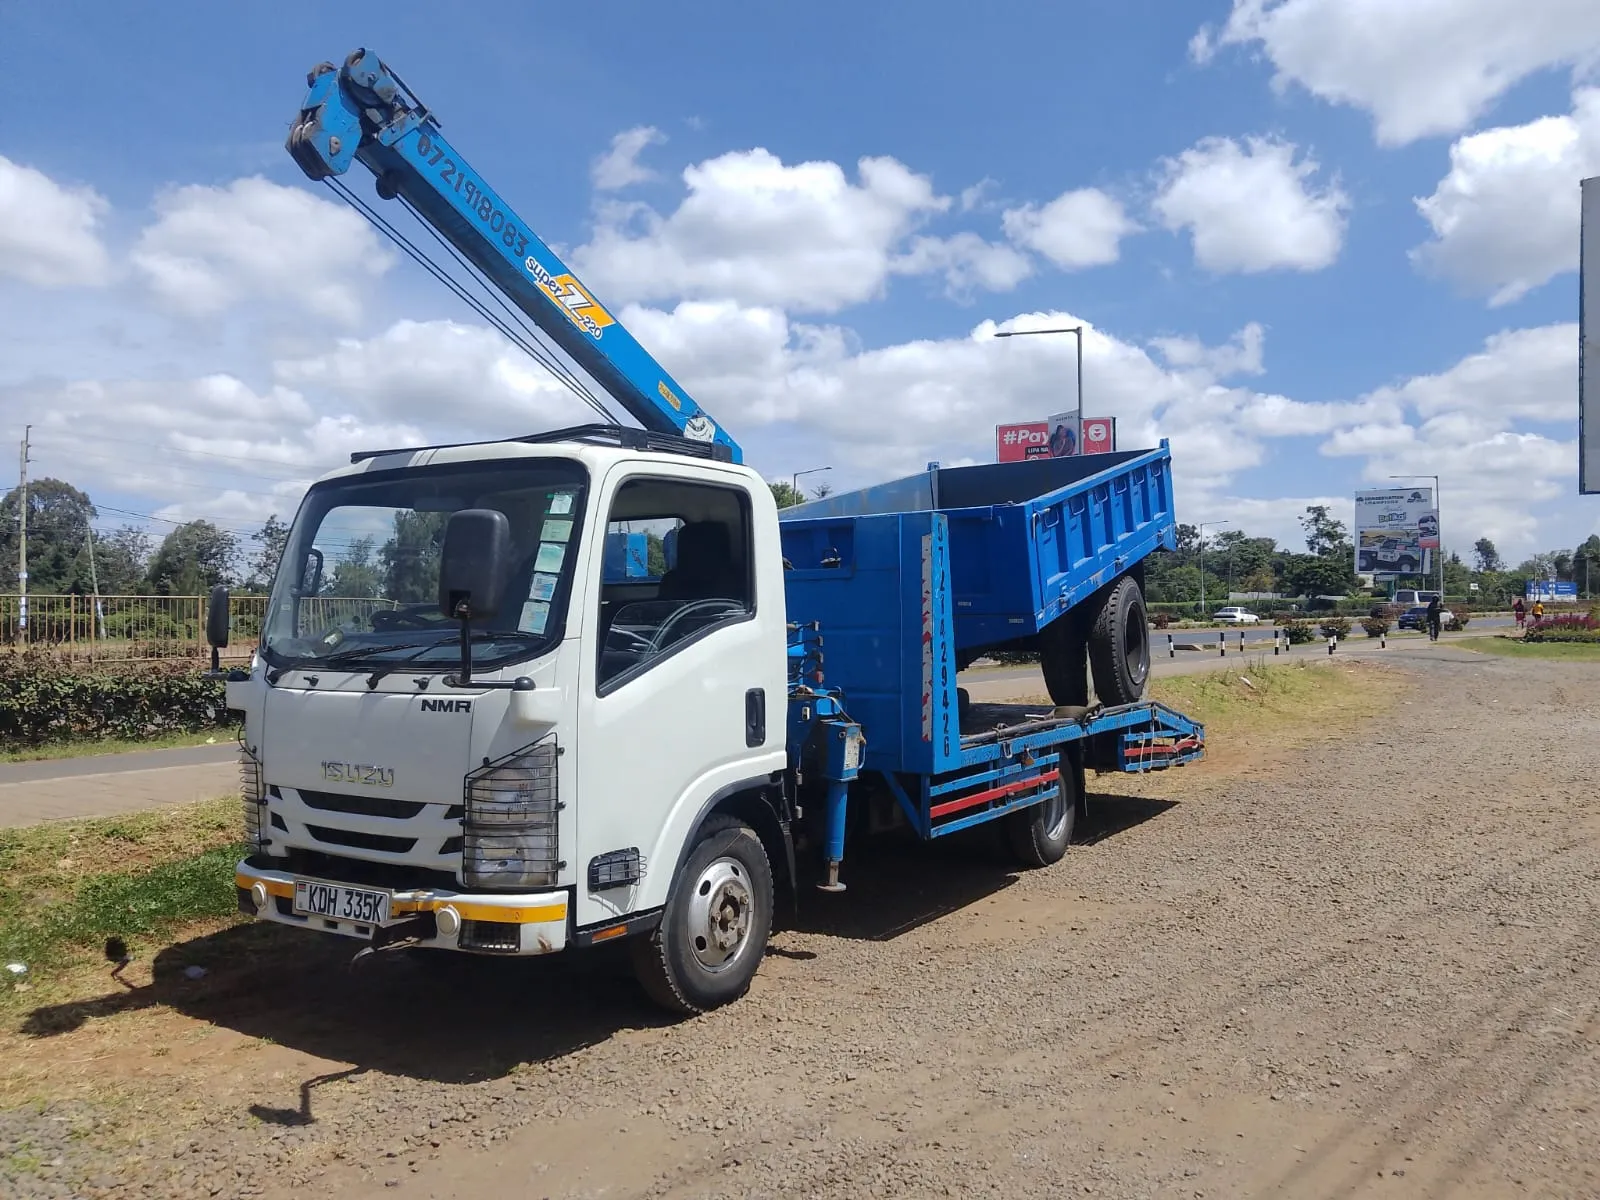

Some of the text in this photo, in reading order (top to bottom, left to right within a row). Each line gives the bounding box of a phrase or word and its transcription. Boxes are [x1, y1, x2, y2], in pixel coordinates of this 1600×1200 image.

[416, 134, 529, 257] 0721918083
[526, 257, 562, 295] super
[583, 316, 602, 339] 220
[421, 699, 471, 713] NMR
[320, 760, 395, 788] ISUZU
[308, 885, 383, 922] KDH 335K
